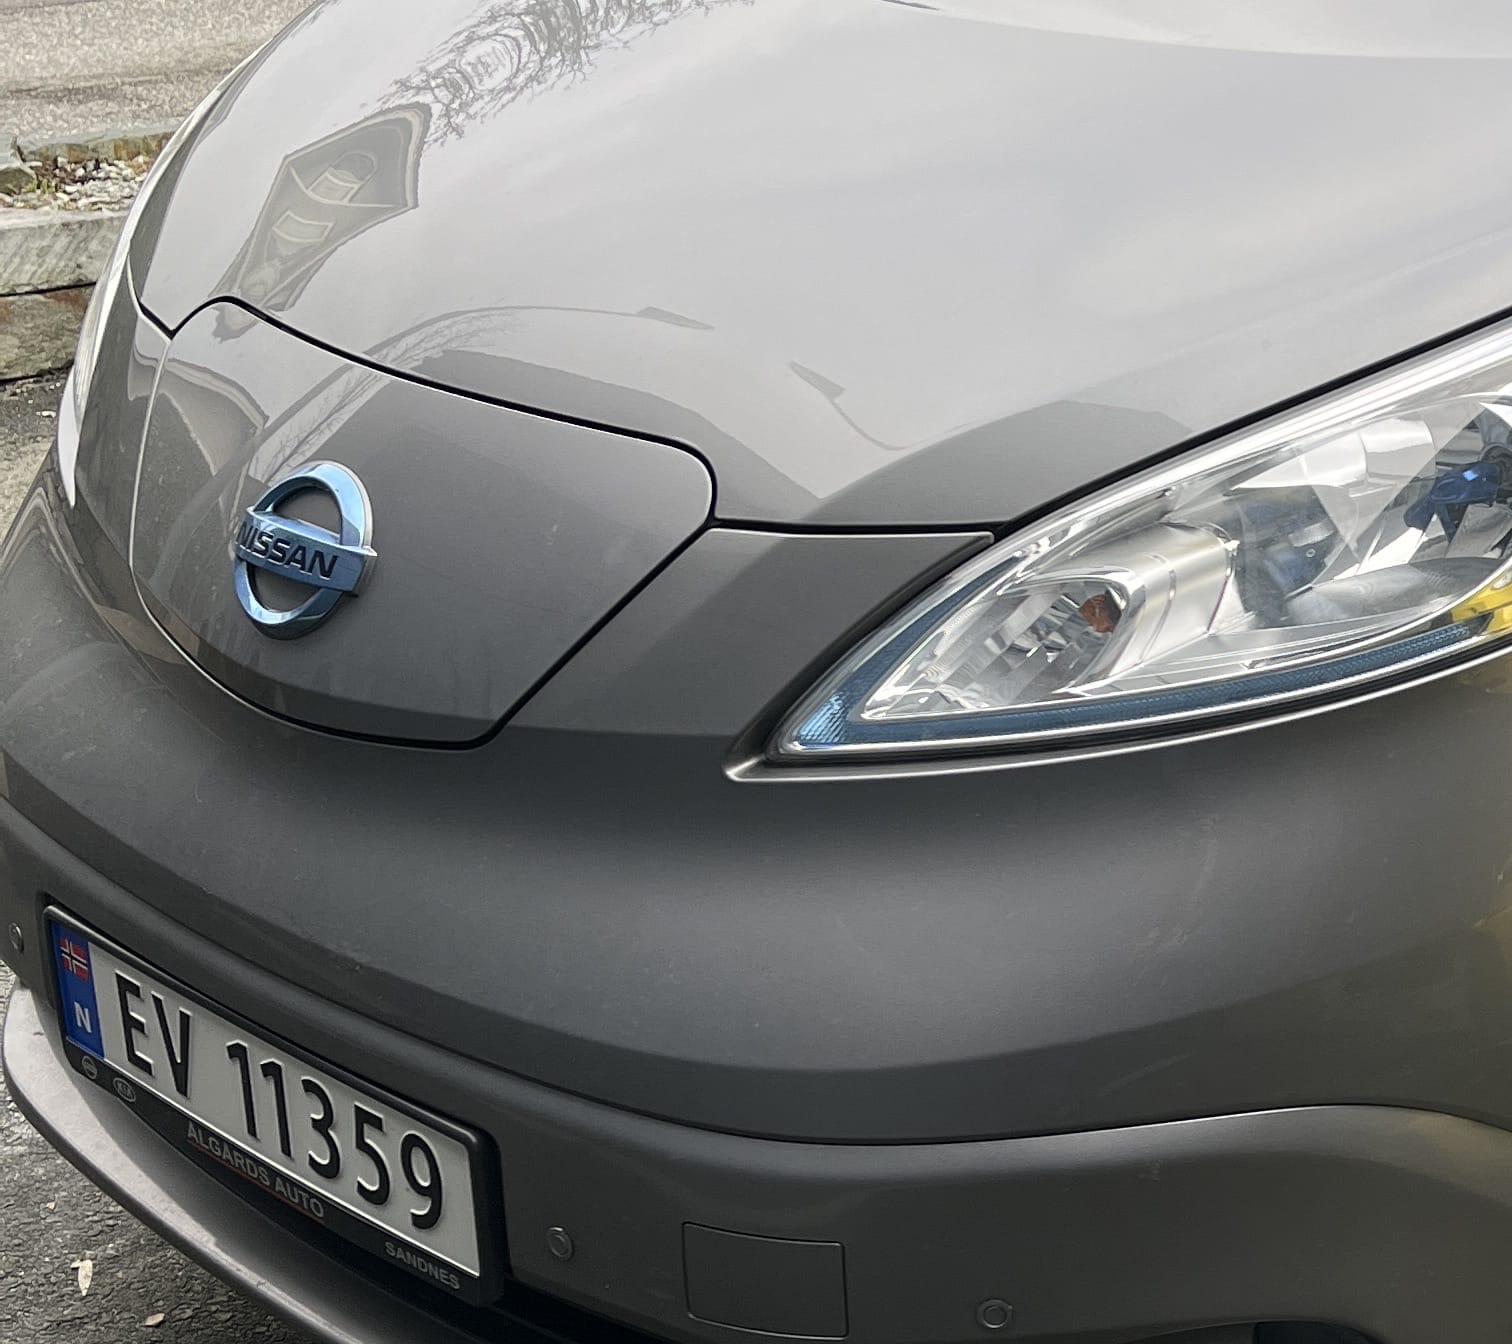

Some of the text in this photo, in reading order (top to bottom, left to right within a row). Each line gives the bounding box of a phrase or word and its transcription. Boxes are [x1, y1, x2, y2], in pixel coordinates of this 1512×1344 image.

[237, 521, 338, 580] NISSAN
[74, 1000, 92, 1033] N
[114, 969, 443, 1231] EV 11359
[274, 1178, 325, 1219] AUTO
[384, 1241, 461, 1290] SANDNES
